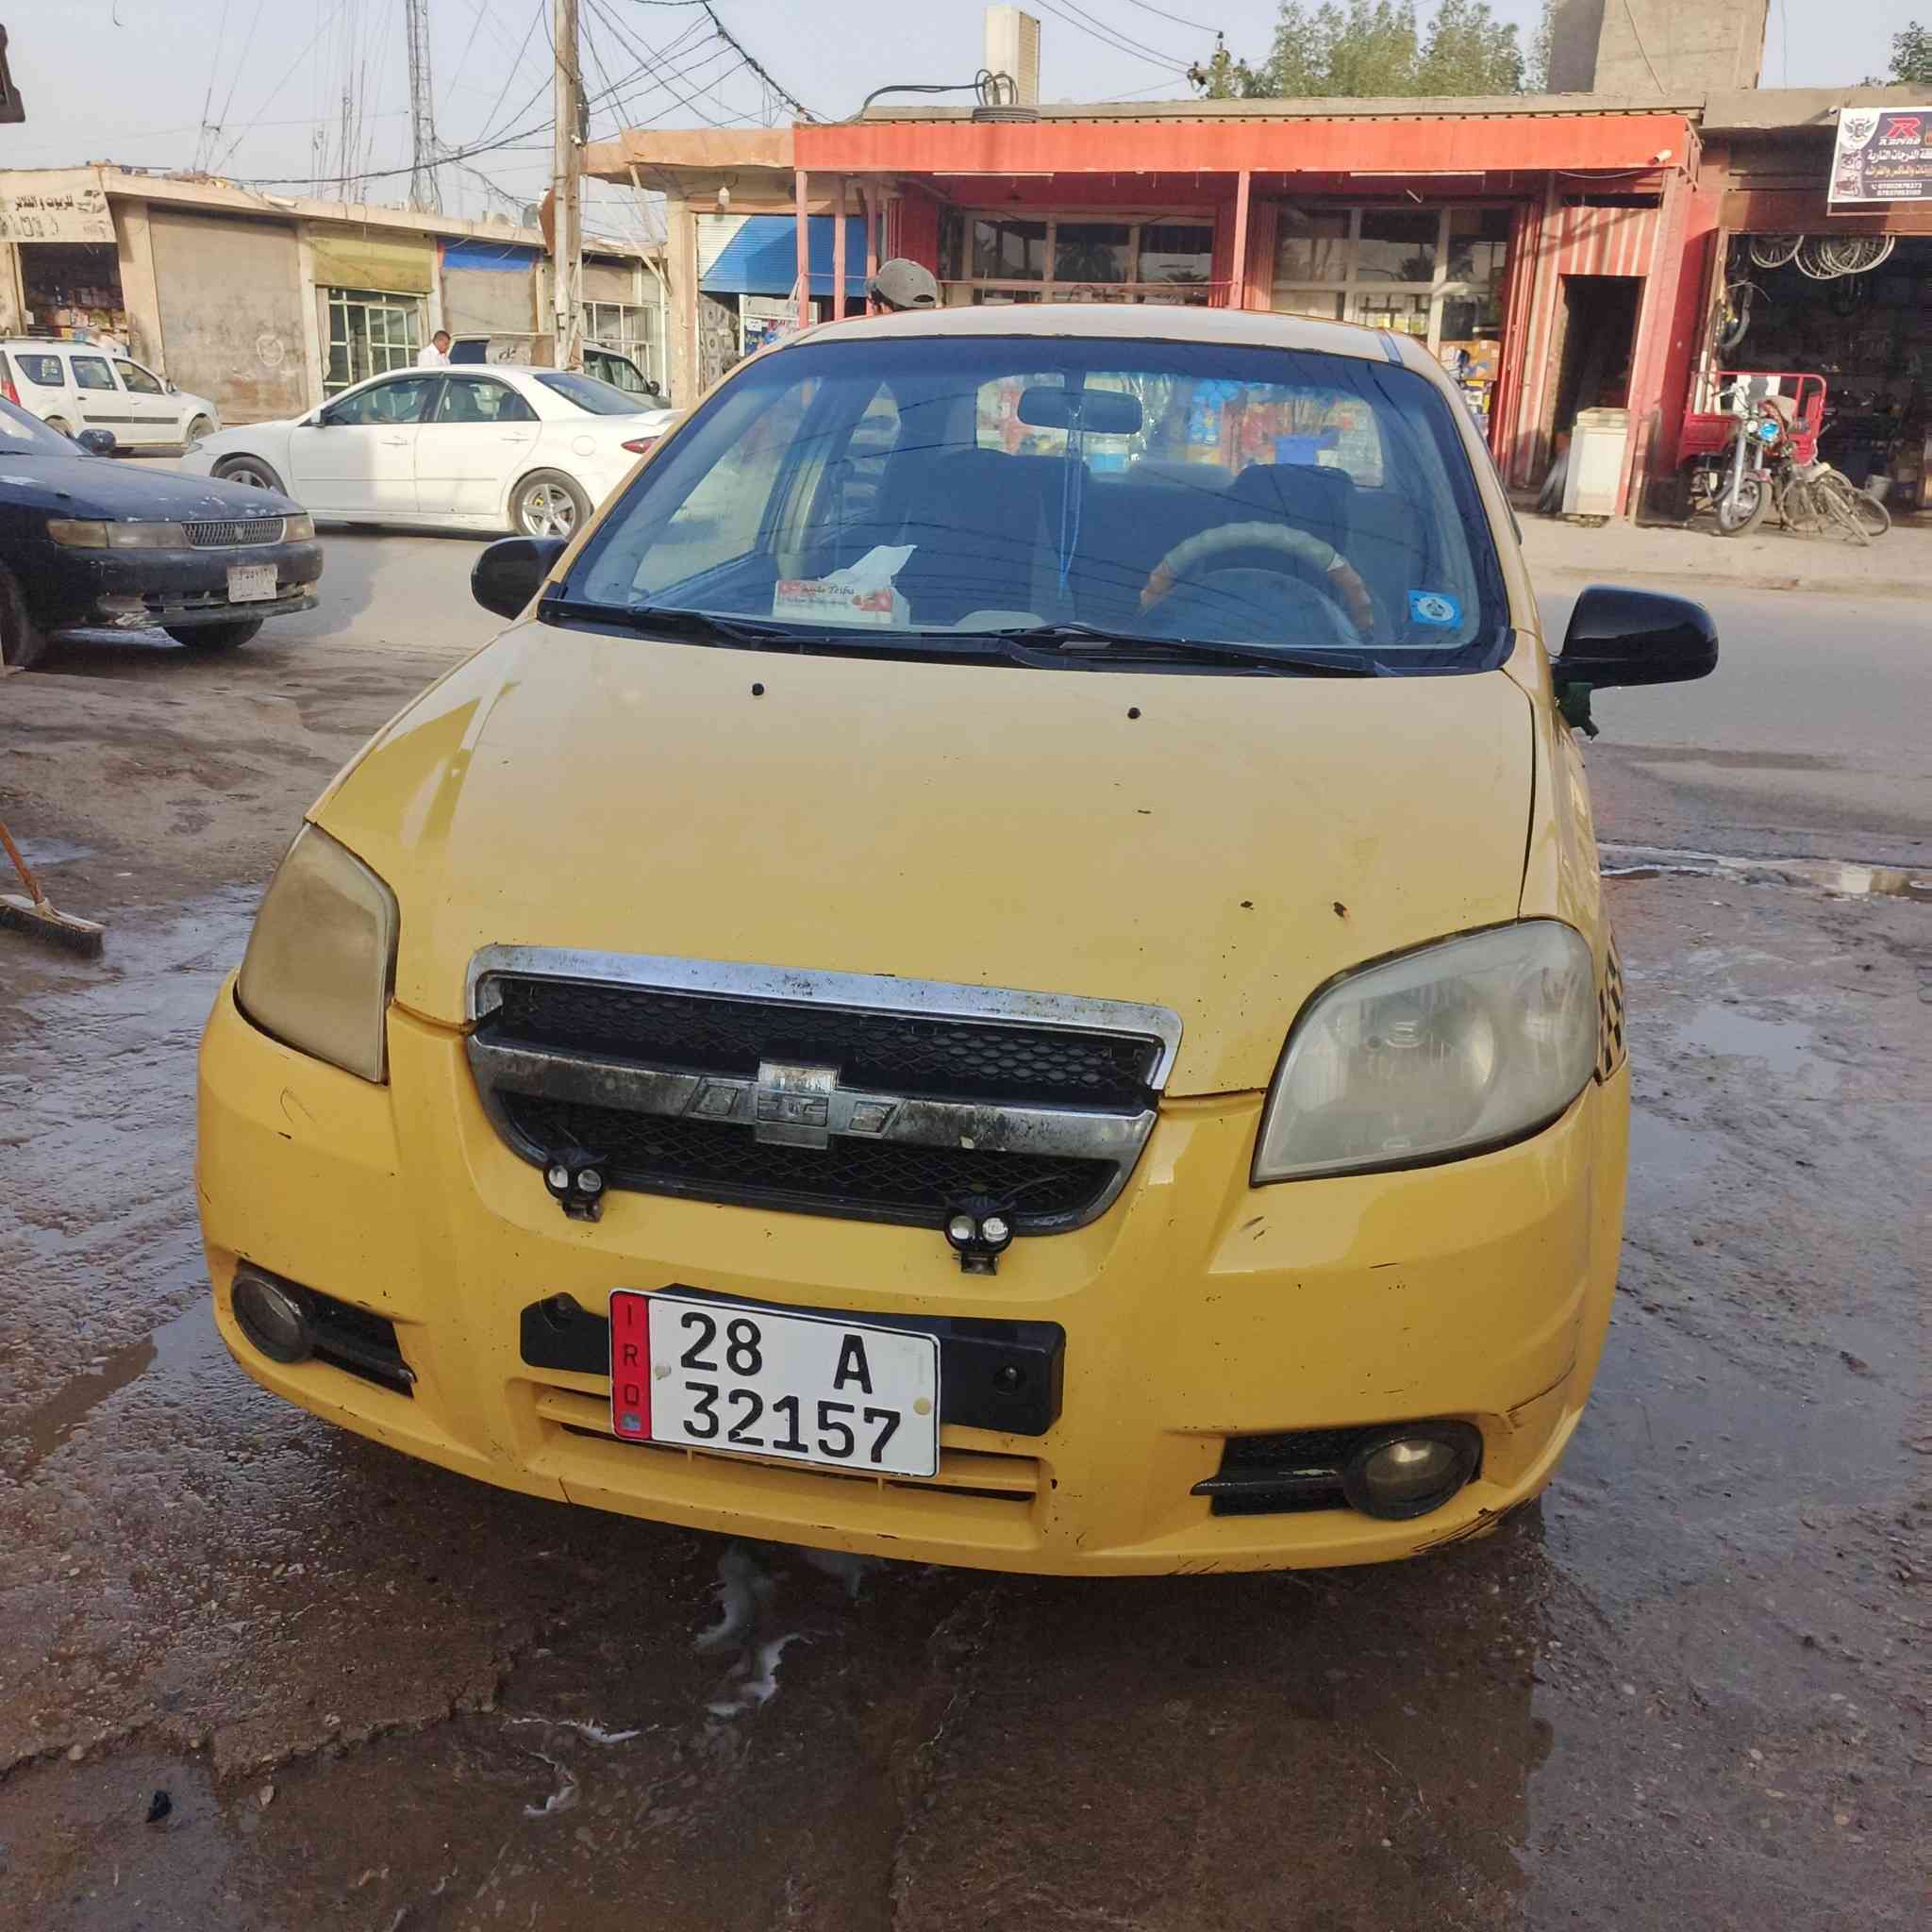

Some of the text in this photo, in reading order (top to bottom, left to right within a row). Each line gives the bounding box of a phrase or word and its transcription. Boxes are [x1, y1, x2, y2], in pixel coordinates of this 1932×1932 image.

[680, 1311, 873, 1394] 28 A
[682, 1381, 901, 1463] 32157
